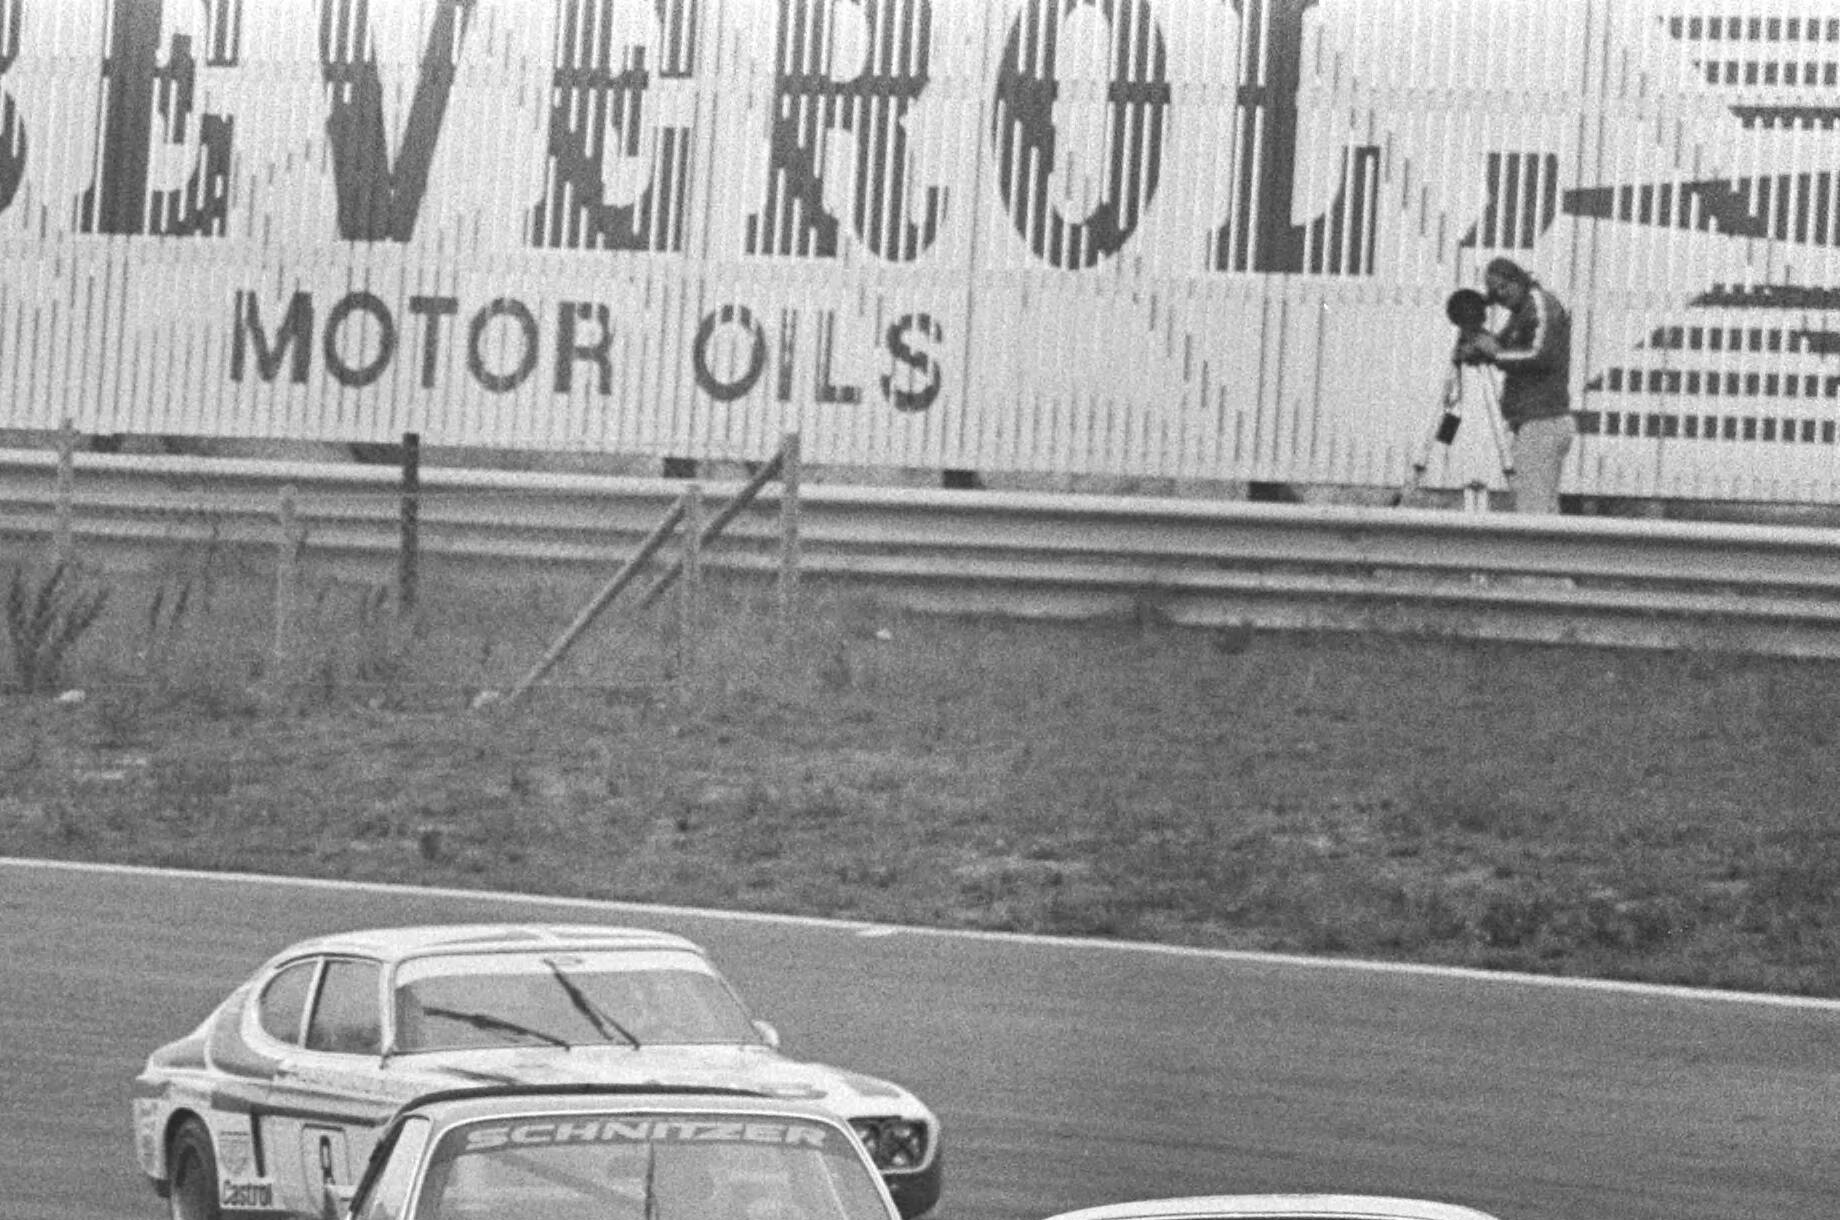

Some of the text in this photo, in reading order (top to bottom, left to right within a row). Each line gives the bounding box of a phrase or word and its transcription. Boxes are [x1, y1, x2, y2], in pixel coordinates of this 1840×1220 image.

[230, 290, 942, 412] MOTOR OILS
[464, 1119, 826, 1151] SCHNITZER
